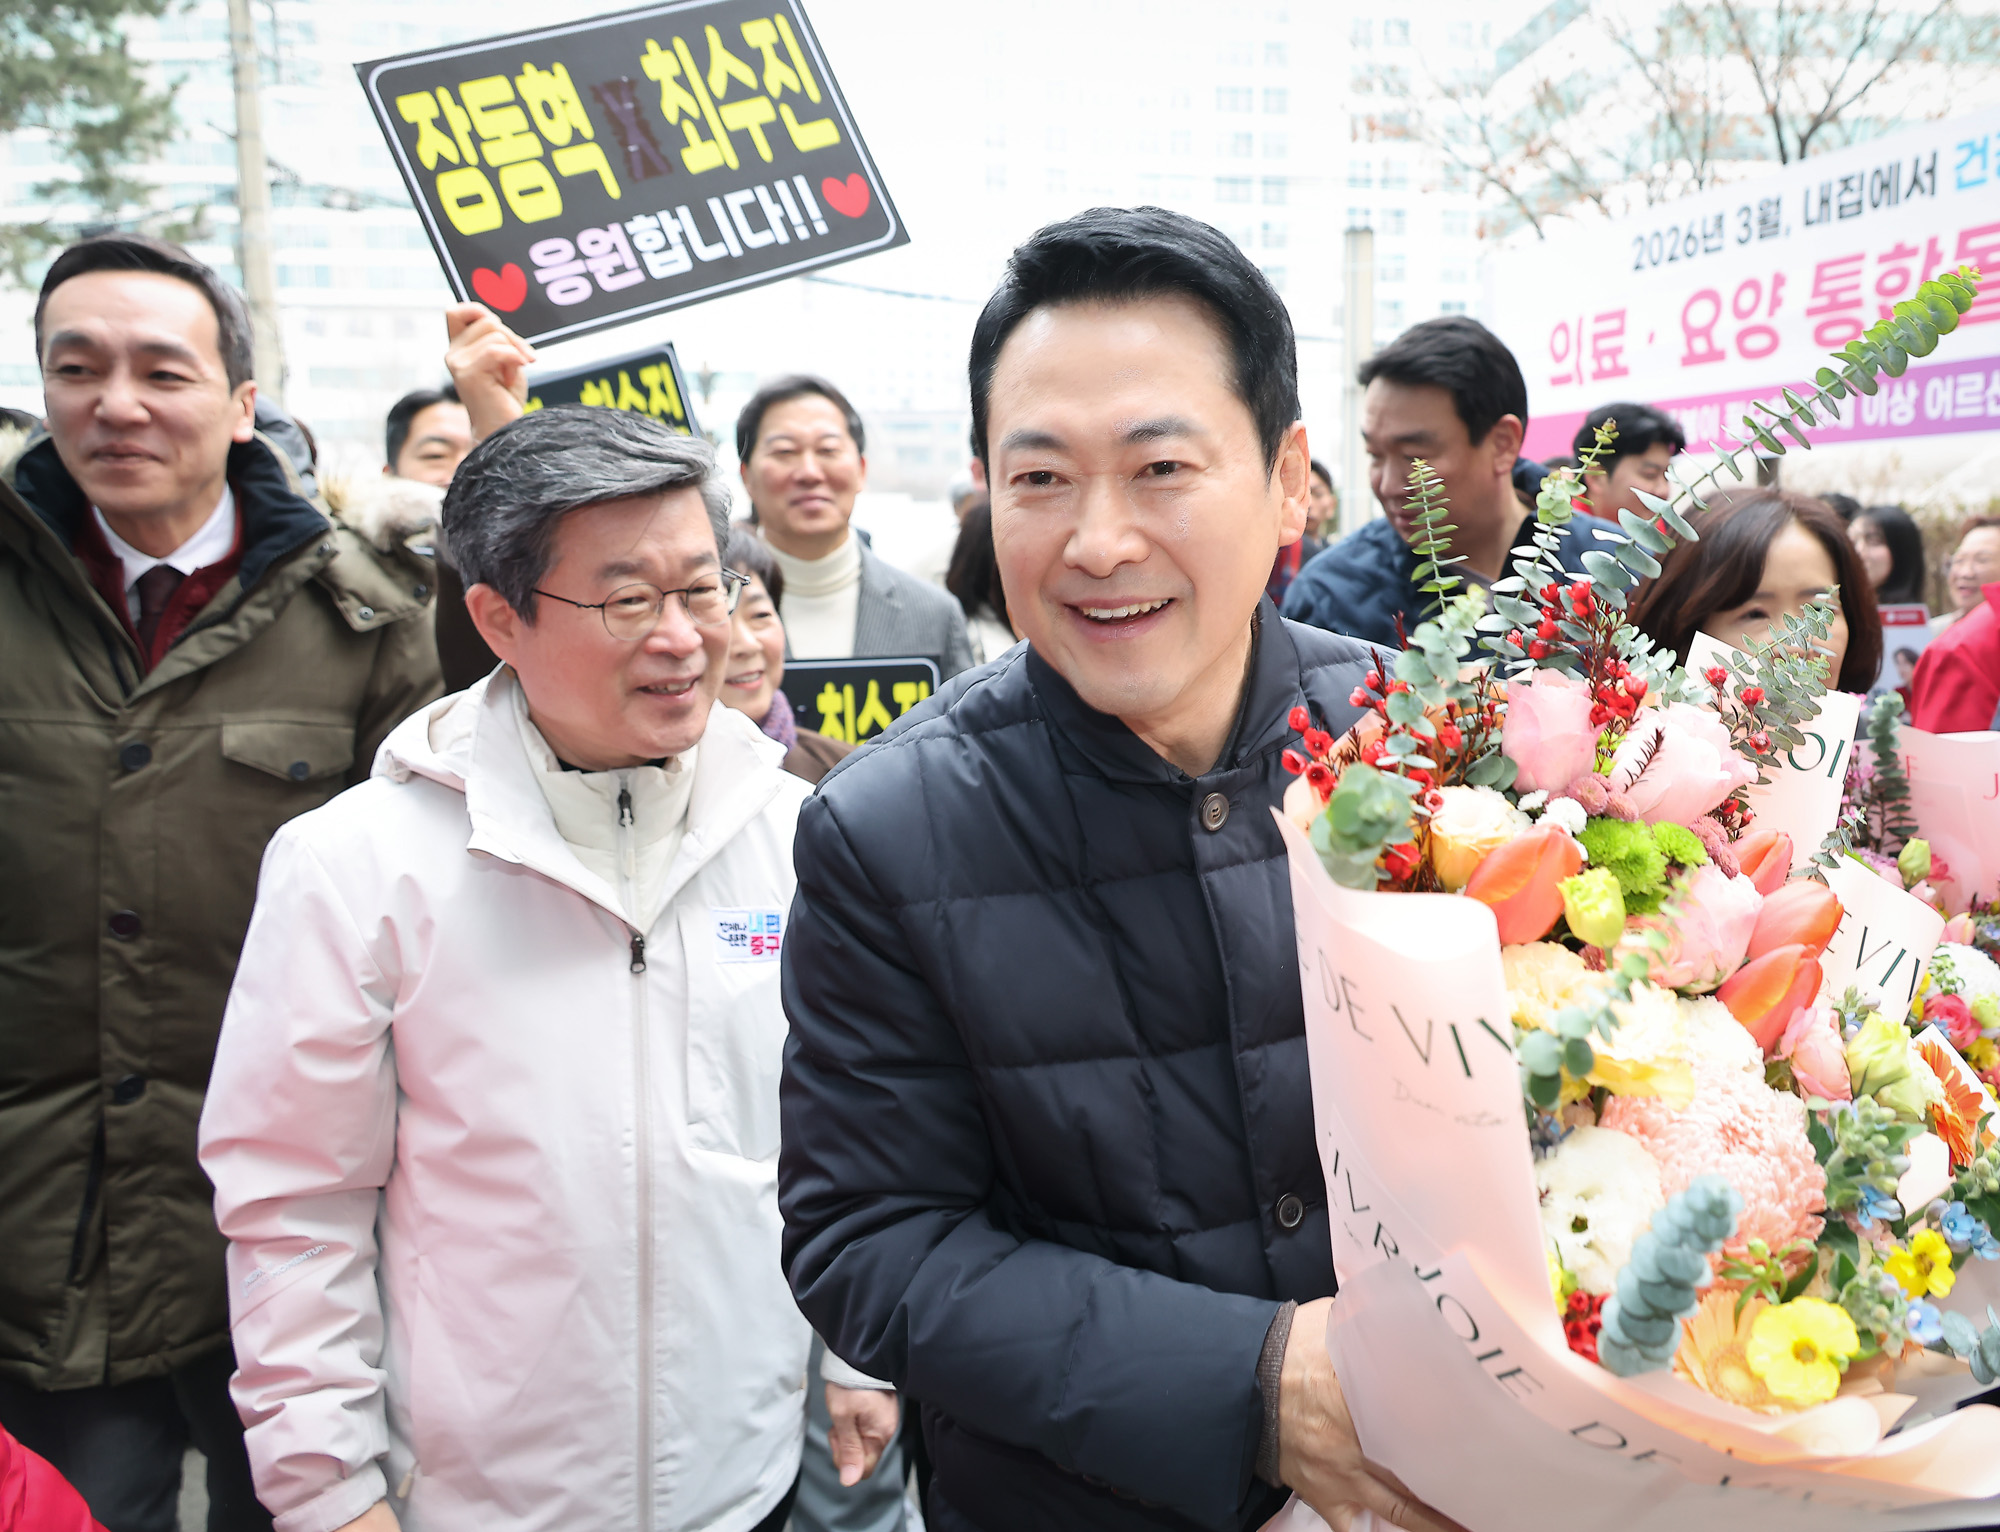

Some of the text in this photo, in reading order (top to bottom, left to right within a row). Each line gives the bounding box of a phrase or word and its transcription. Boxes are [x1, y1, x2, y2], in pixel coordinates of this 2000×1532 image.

[395, 62, 622, 236] 장동혁
[640, 12, 841, 175] 최수진
[528, 174, 829, 307] 응원합니다!!
[1632, 134, 2000, 272] 2026년 3월, 내집에서 건
[1549, 307, 1630, 387] 의료
[1680, 271, 1787, 367] 요양
[749, 935, 781, 956] 중구
[1414, 1262, 1545, 1400] JOIE
